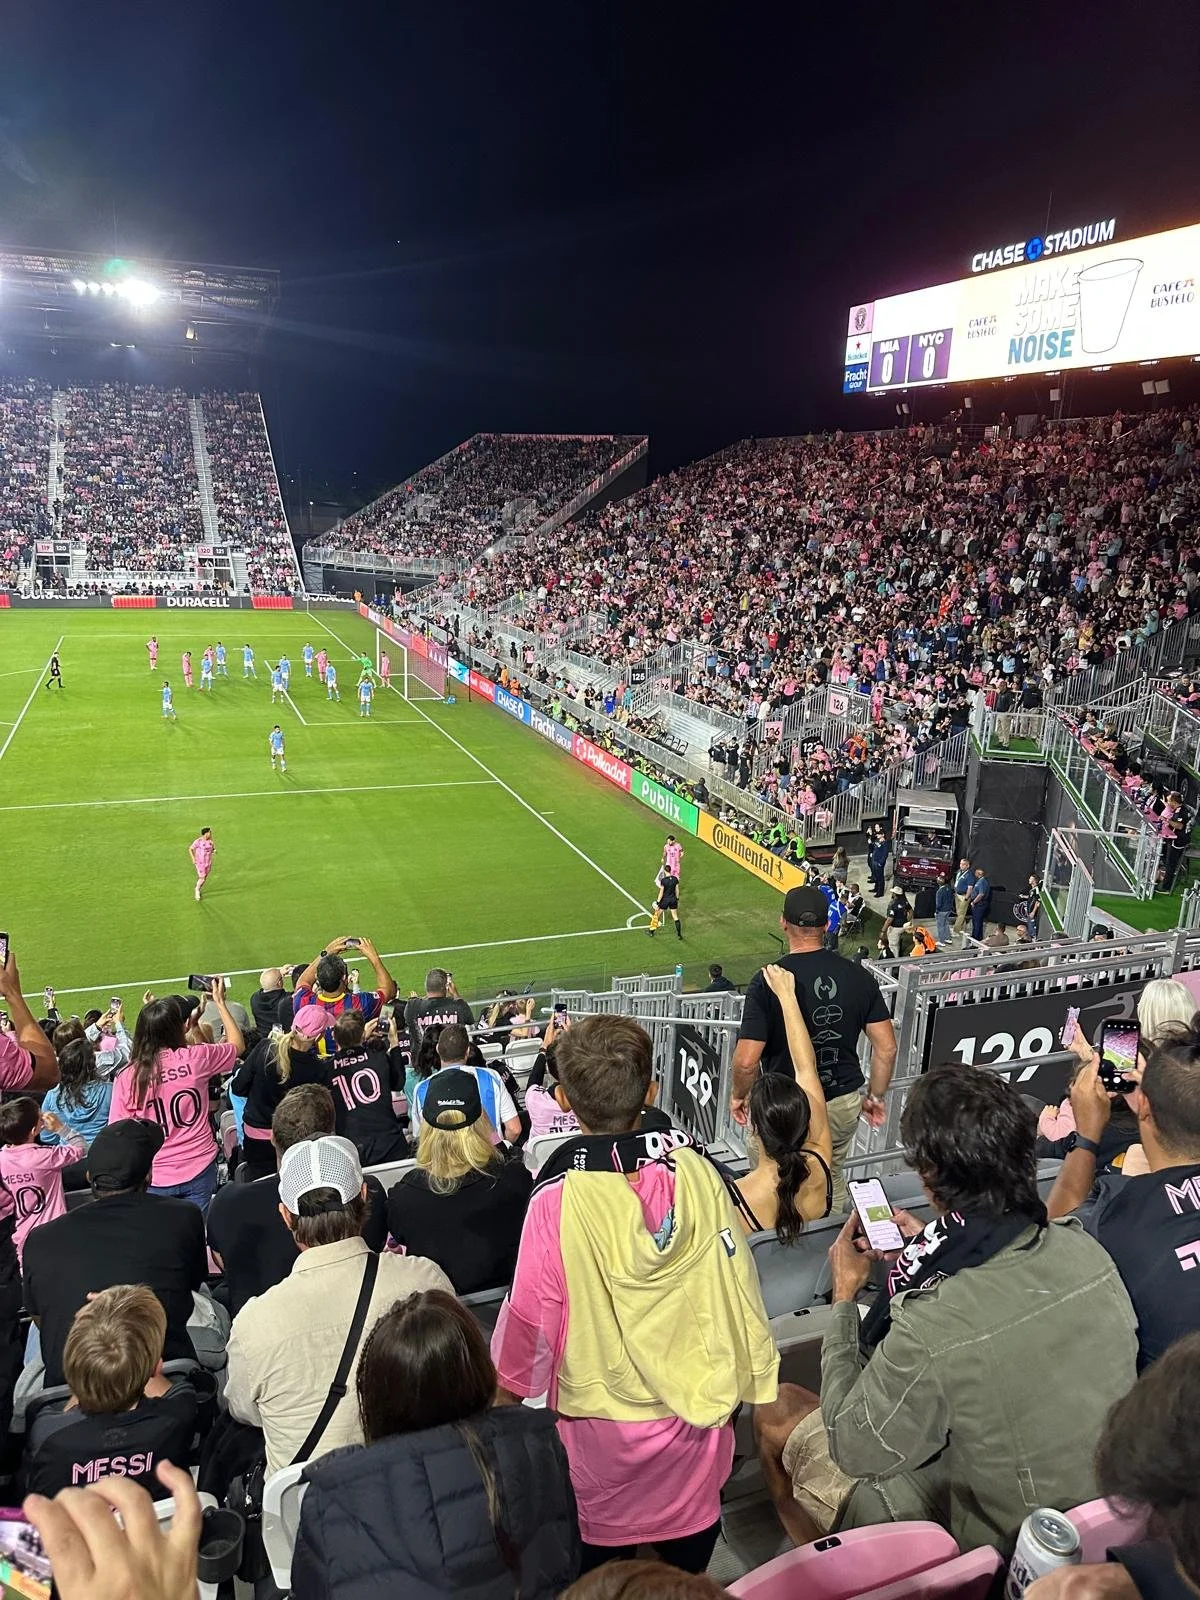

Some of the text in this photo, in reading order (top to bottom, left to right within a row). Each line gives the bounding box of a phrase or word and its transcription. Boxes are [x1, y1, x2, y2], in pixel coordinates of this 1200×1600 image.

[971, 218, 1115, 273] CHASE STADIUM
[1014, 263, 1080, 307] MAKE
[1012, 297, 1080, 336] SOME
[879, 340, 900, 354] MIA
[918, 331, 945, 348] NYC
[1008, 328, 1076, 365] NOISE
[845, 368, 867, 382] Fracht
[881, 353, 894, 384] 0
[921, 346, 936, 379] 0
[166, 597, 230, 608] DURACELL
[547, 637, 558, 645] 124
[631, 672, 645, 682] 125
[497, 690, 519, 714] CHASE
[833, 699, 844, 710] 126
[531, 709, 572, 751] Fracht GROUP
[588, 746, 628, 785] Polkadot
[641, 780, 680, 819] Publix
[712, 823, 774, 879] Continental
[417, 1014, 458, 1027] MIAMI
[333, 1052, 369, 1070] MESSI
[952, 1027, 1054, 1084] 129
[159, 1063, 193, 1084] ESSI
[331, 1067, 381, 1112] 10
[679, 1047, 713, 1107] 129
[146, 1088, 202, 1138] 10
[15, 1185, 46, 1218] 0
[72, 1451, 153, 1485] MESSI
